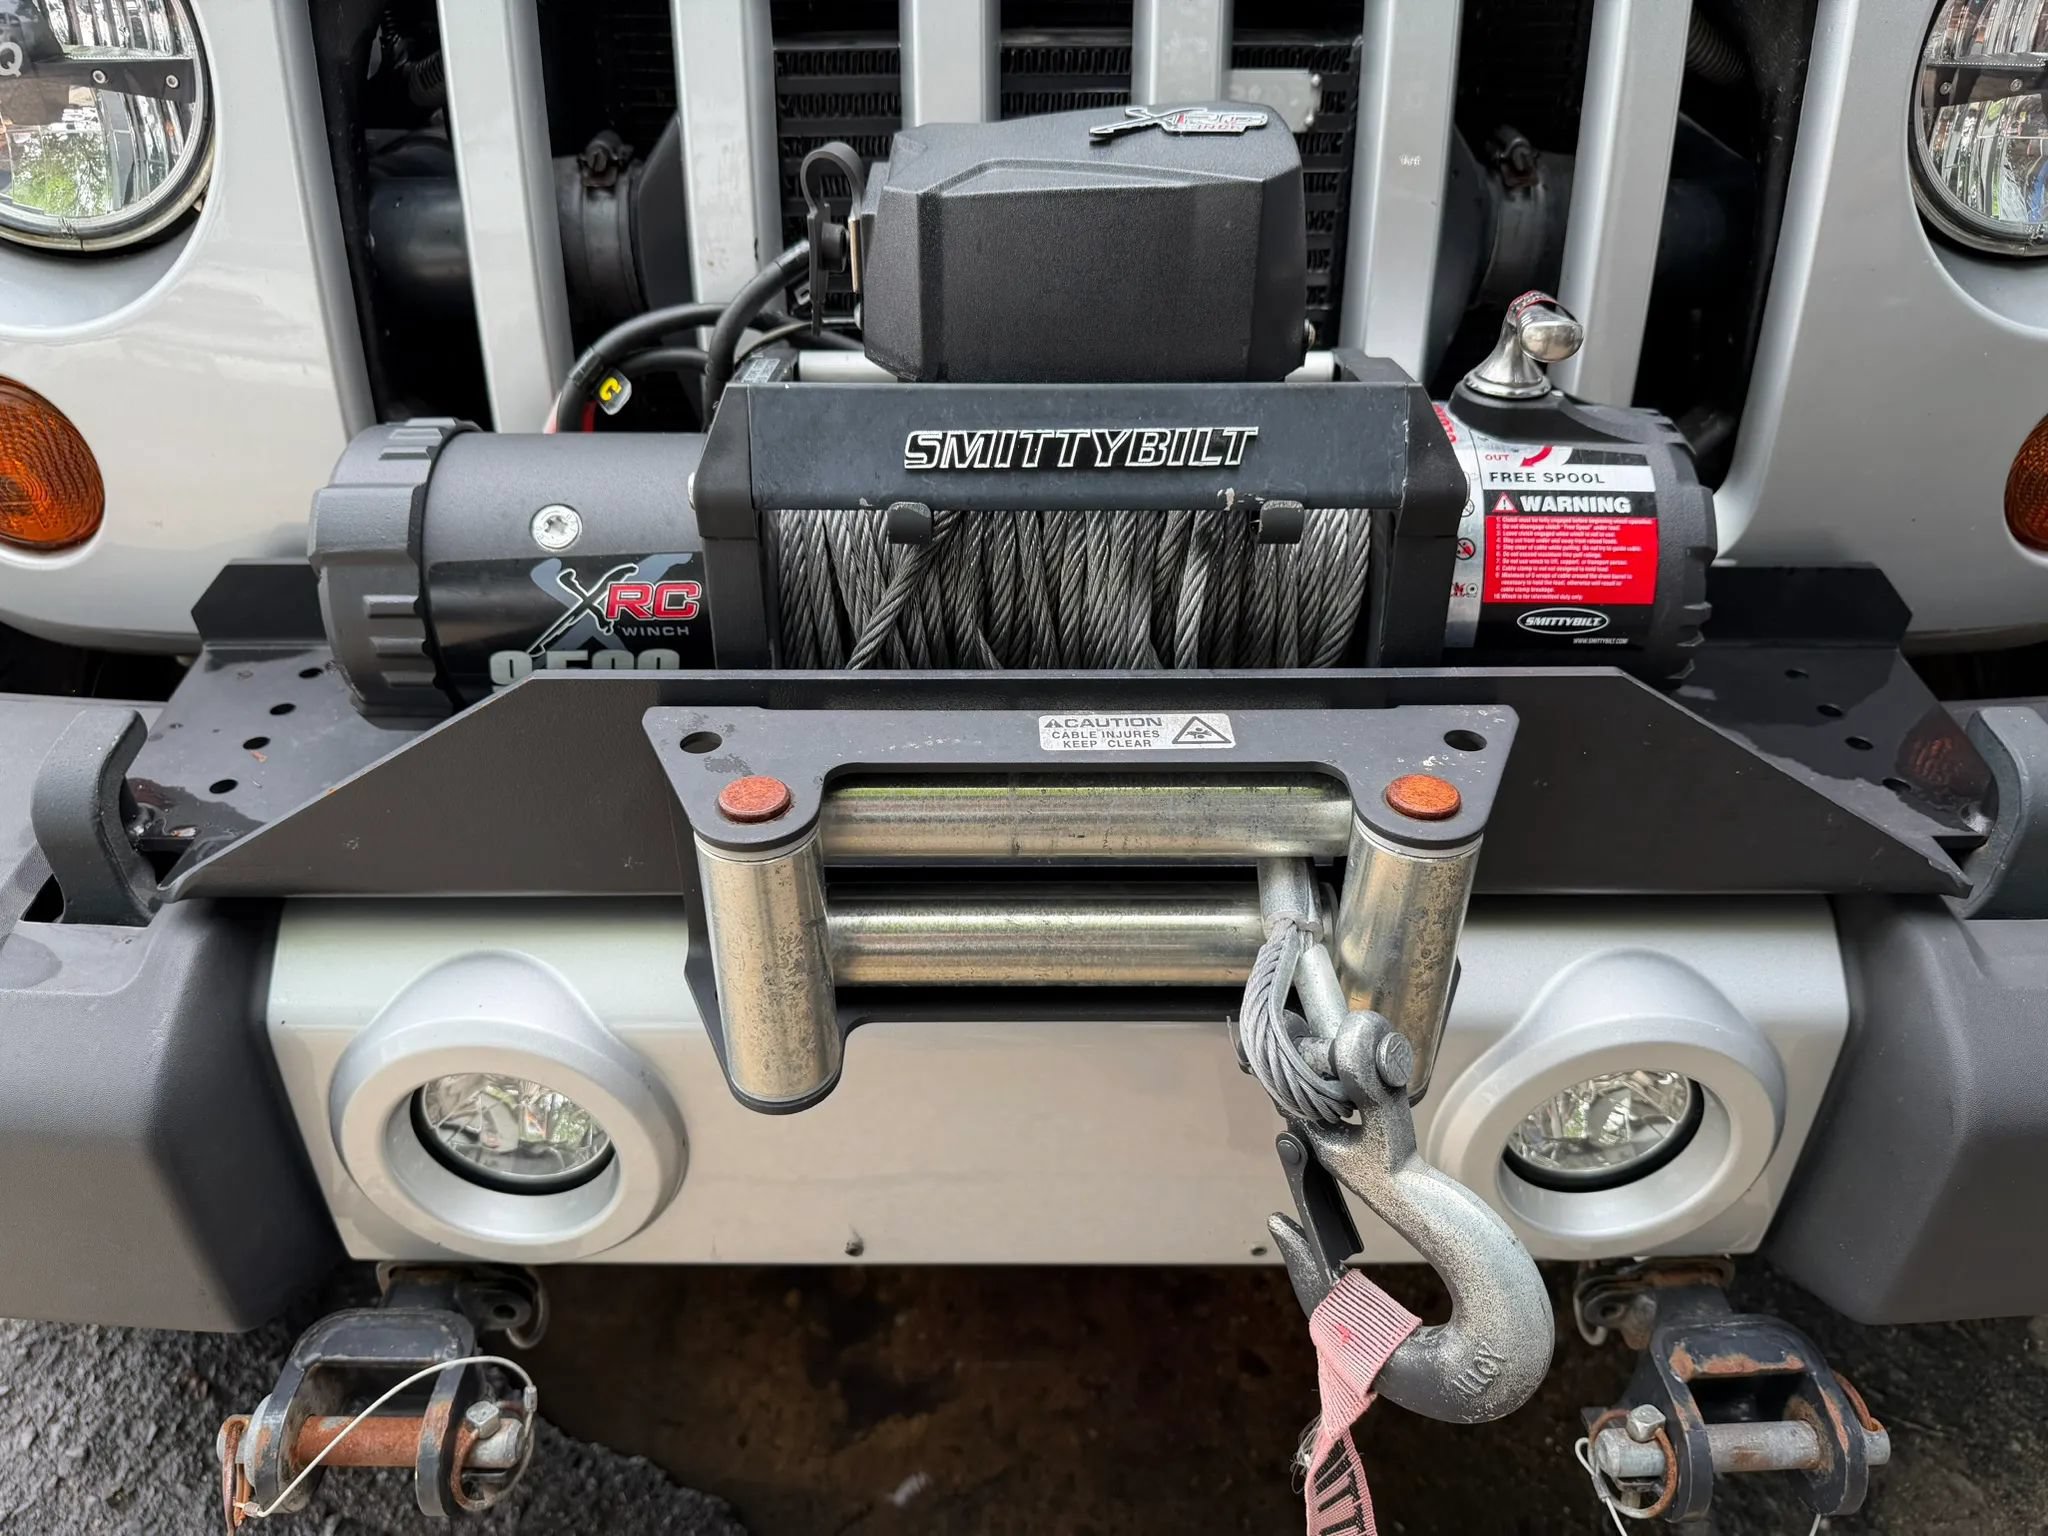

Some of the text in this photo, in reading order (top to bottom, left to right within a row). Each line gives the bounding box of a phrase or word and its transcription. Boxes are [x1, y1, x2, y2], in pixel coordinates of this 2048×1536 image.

[904, 427, 1259, 469] SMITTYBILT
[1485, 453, 1510, 462] OUT
[1490, 472, 1605, 484] FREE SPOOL
[1519, 495, 1632, 514] WARNING
[527, 558, 702, 656] XRC
[1525, 616, 1602, 627] SMITTYBILT
[622, 626, 690, 636] WINCH
[1064, 716, 1163, 728] CAUTION
[1052, 730, 1160, 739] CABLE INJURES
[1063, 739, 1152, 748] KEEP CLEAR
